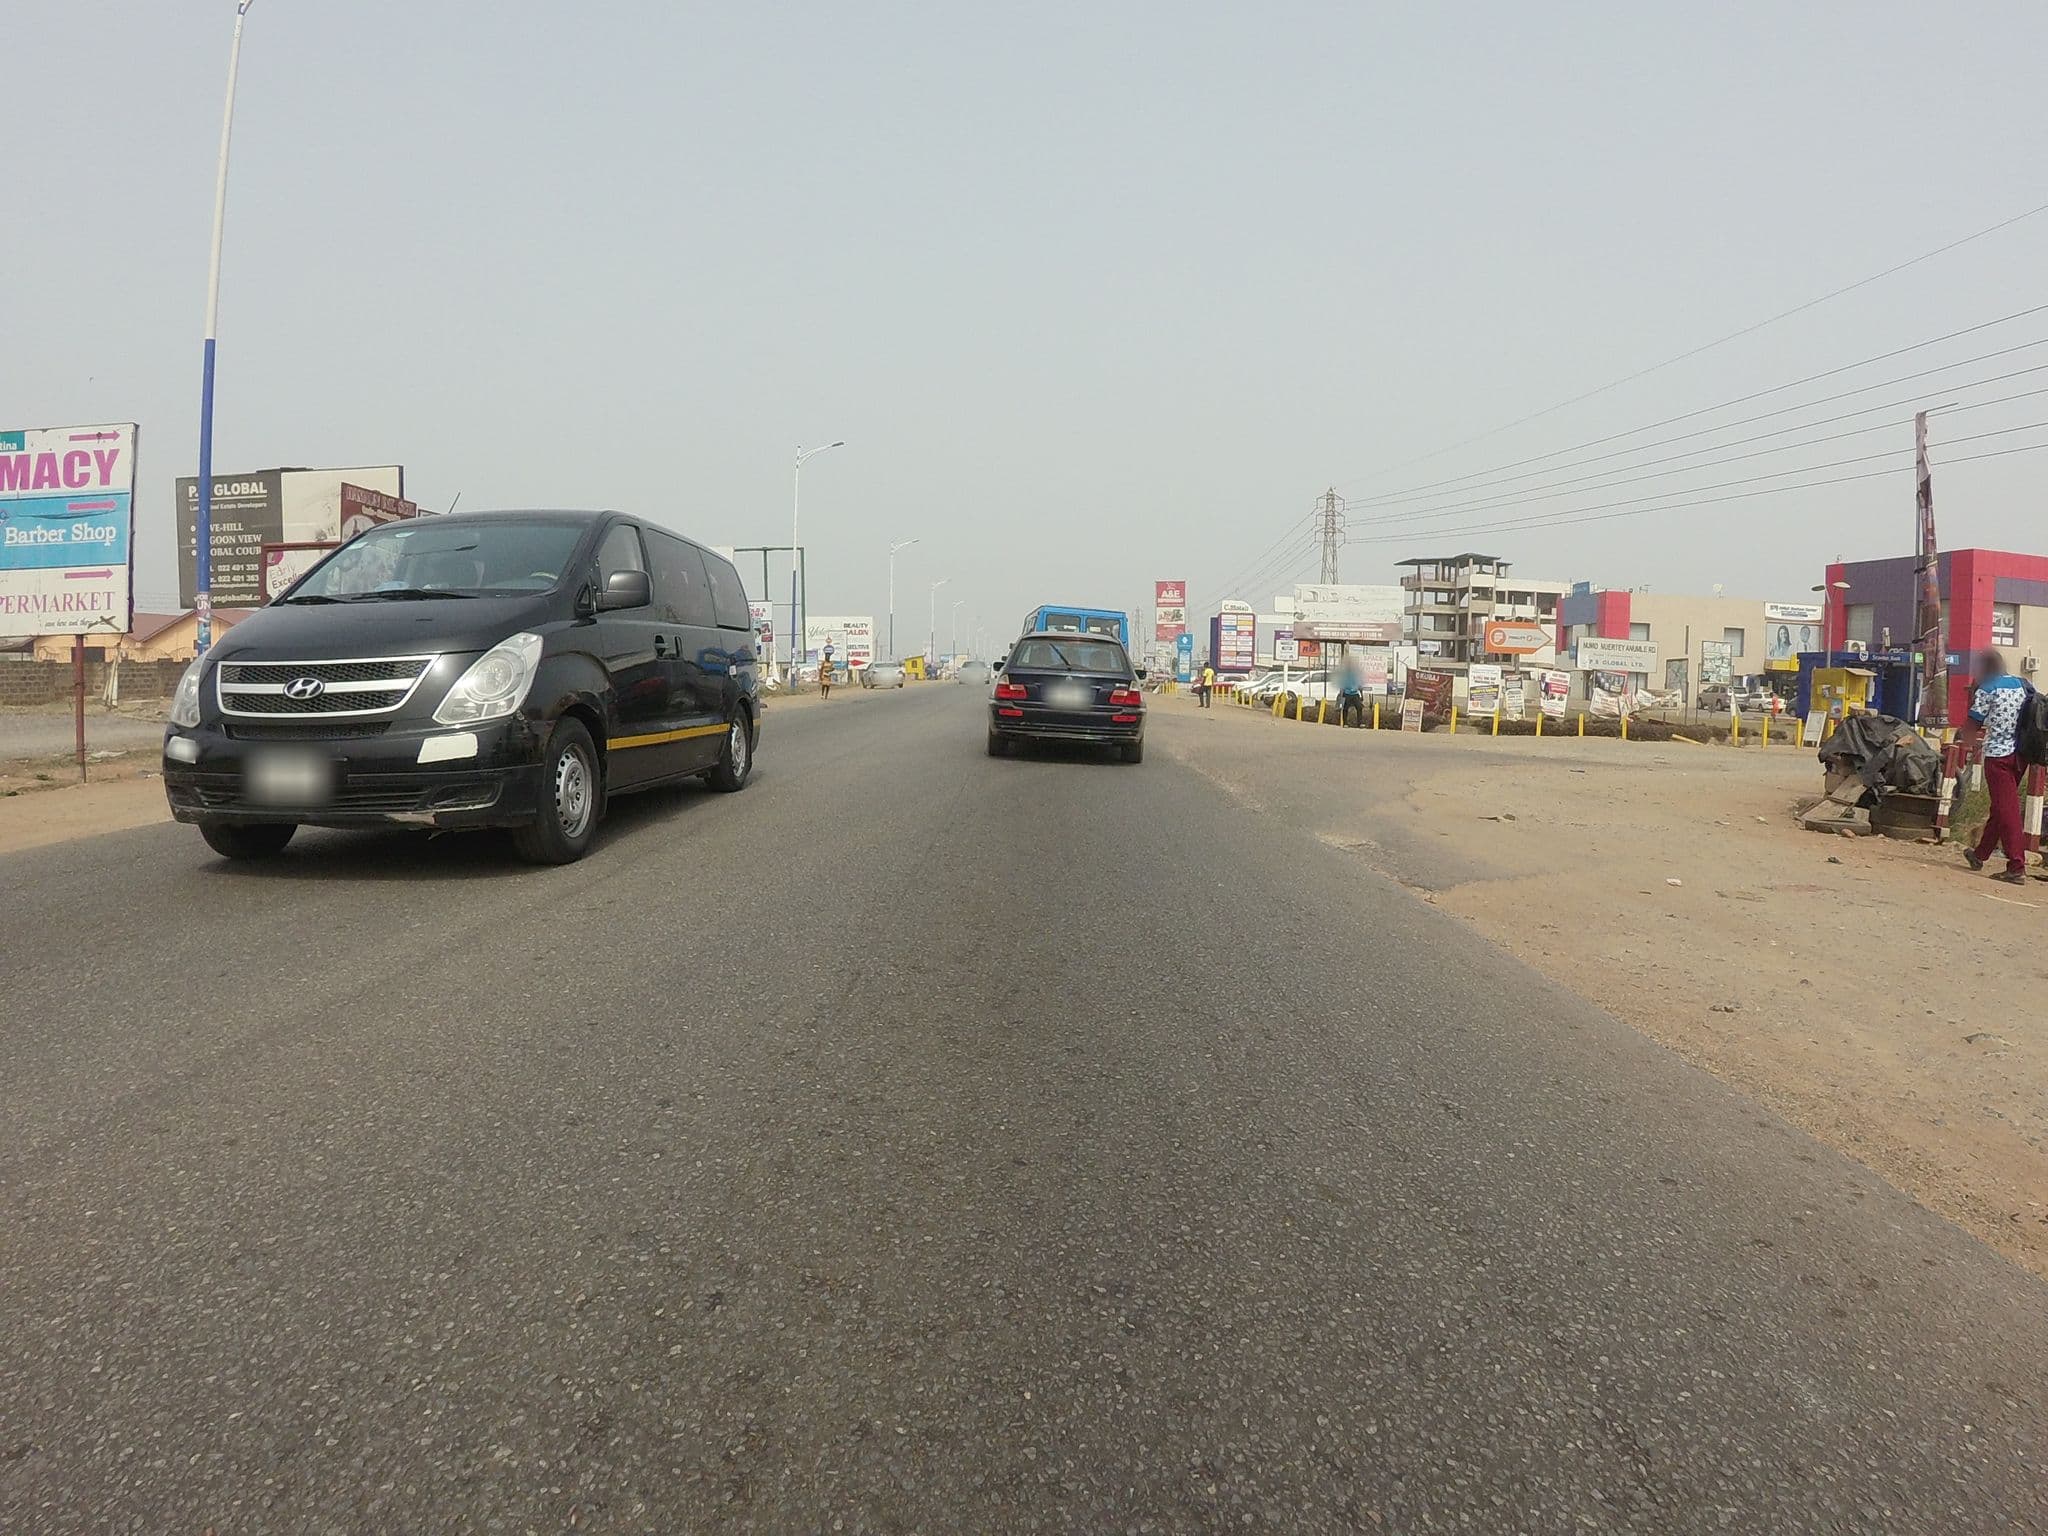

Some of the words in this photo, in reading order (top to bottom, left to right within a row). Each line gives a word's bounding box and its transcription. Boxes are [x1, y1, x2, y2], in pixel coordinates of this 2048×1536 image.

[213, 482, 268, 496] GLOBAL
[5, 524, 67, 544] Barber
[71, 521, 117, 546] Shop
[238, 533, 262, 543] VIEW
